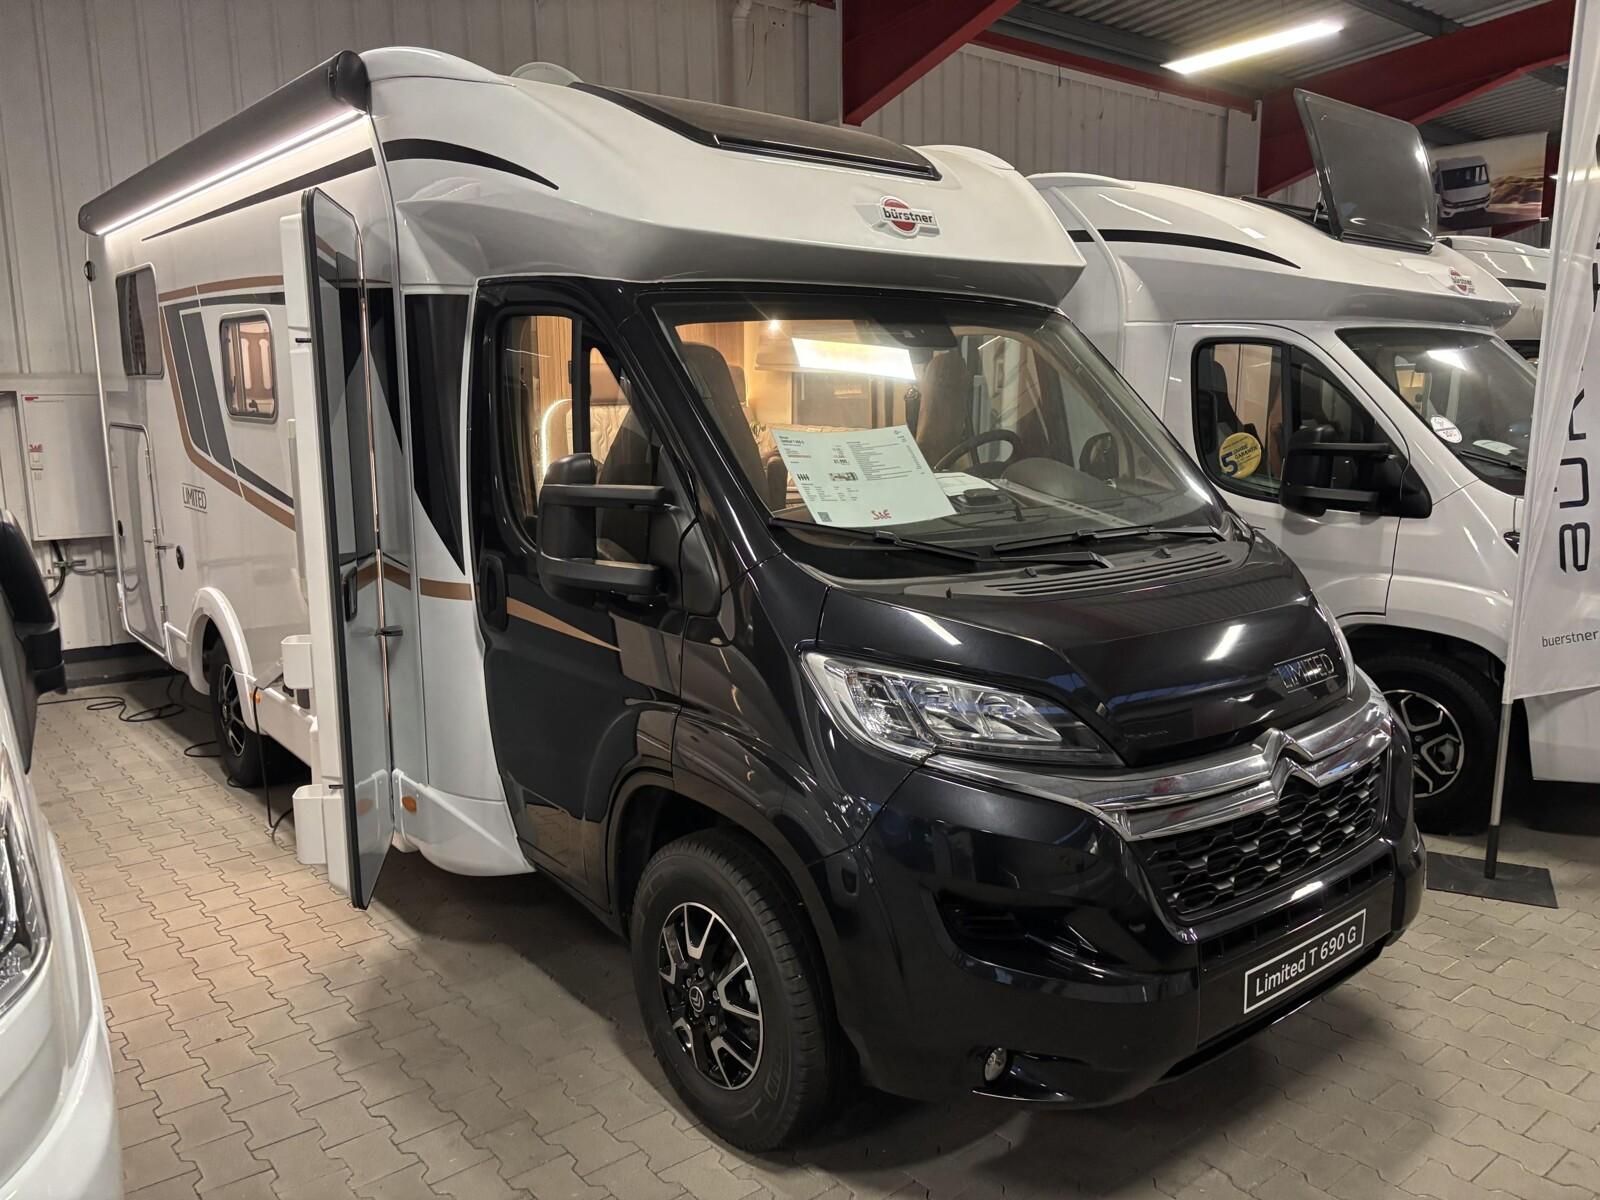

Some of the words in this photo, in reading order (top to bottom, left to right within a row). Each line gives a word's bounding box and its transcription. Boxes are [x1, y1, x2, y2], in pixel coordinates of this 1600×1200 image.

[883, 207, 934, 224] bürstner
[1221, 451, 1238, 477] 5
[182, 486, 207, 510] LIMITED
[1541, 630, 1600, 648] buerstner
[1276, 653, 1335, 689] LIMITED
[1256, 952, 1306, 997] Limited
[1308, 947, 1318, 967] T
[1320, 932, 1345, 960] 690
[1347, 925, 1357, 944] G
